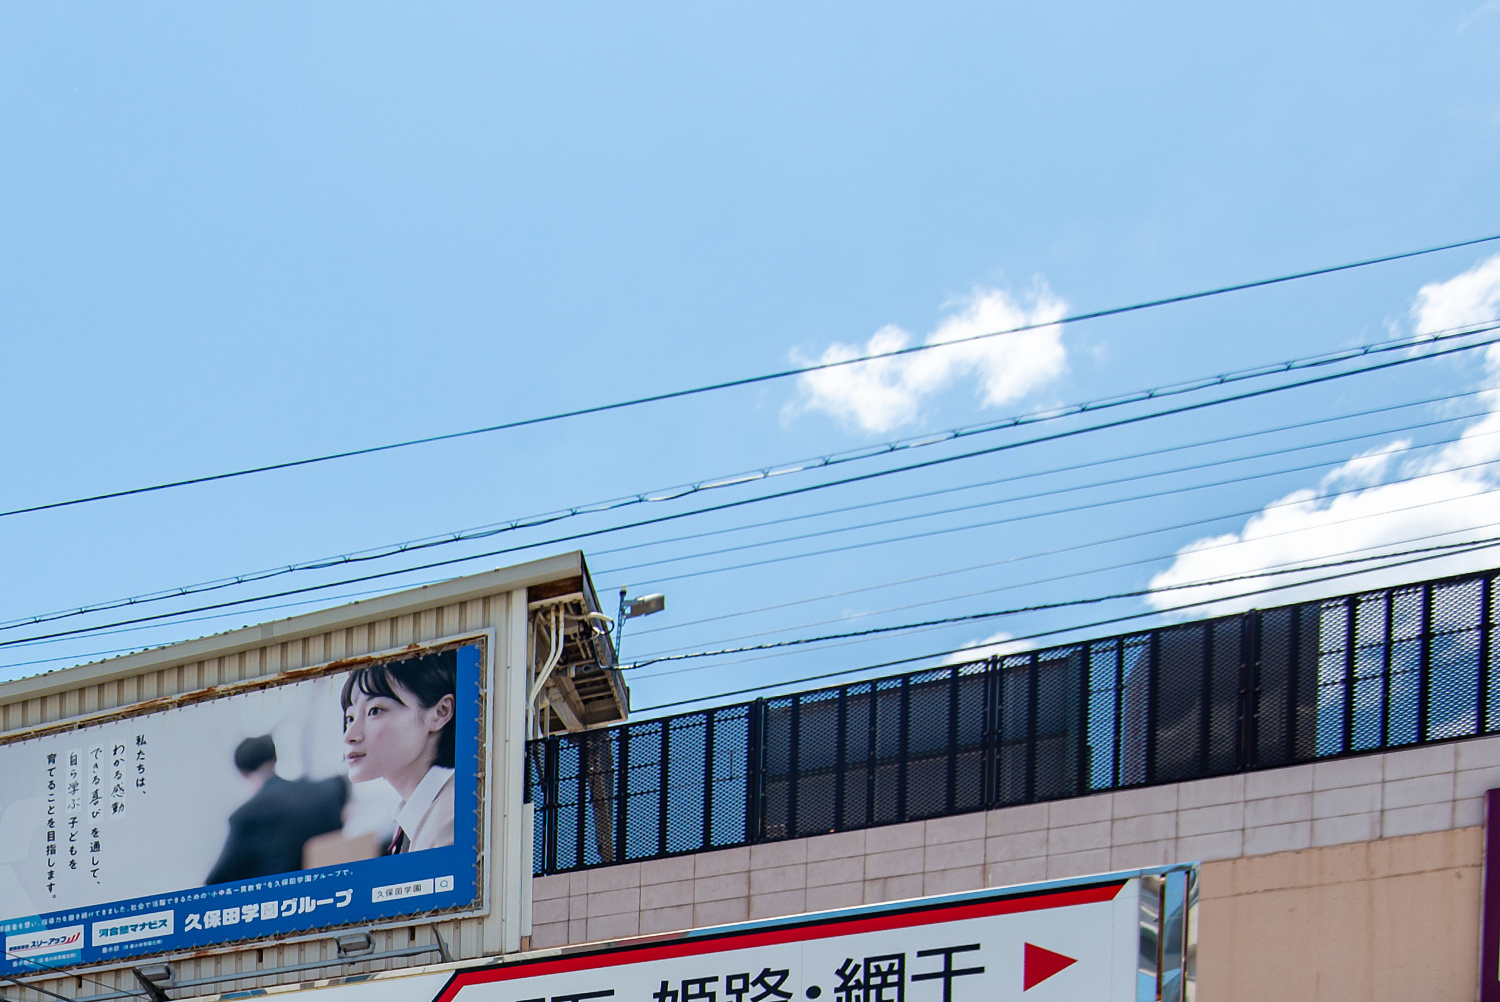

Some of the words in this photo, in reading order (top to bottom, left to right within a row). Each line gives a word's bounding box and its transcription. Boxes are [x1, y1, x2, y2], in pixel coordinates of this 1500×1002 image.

[111, 743, 127, 816] わかる感動
[135, 734, 148, 796] 私たちは、
[46, 752, 59, 899] 育てることを目指します。
[67, 751, 81, 871] 自ら学ぶ子どもを
[185, 888, 355, 932] 久保田学園グループ
[376, 884, 422, 899] 久保田学園
